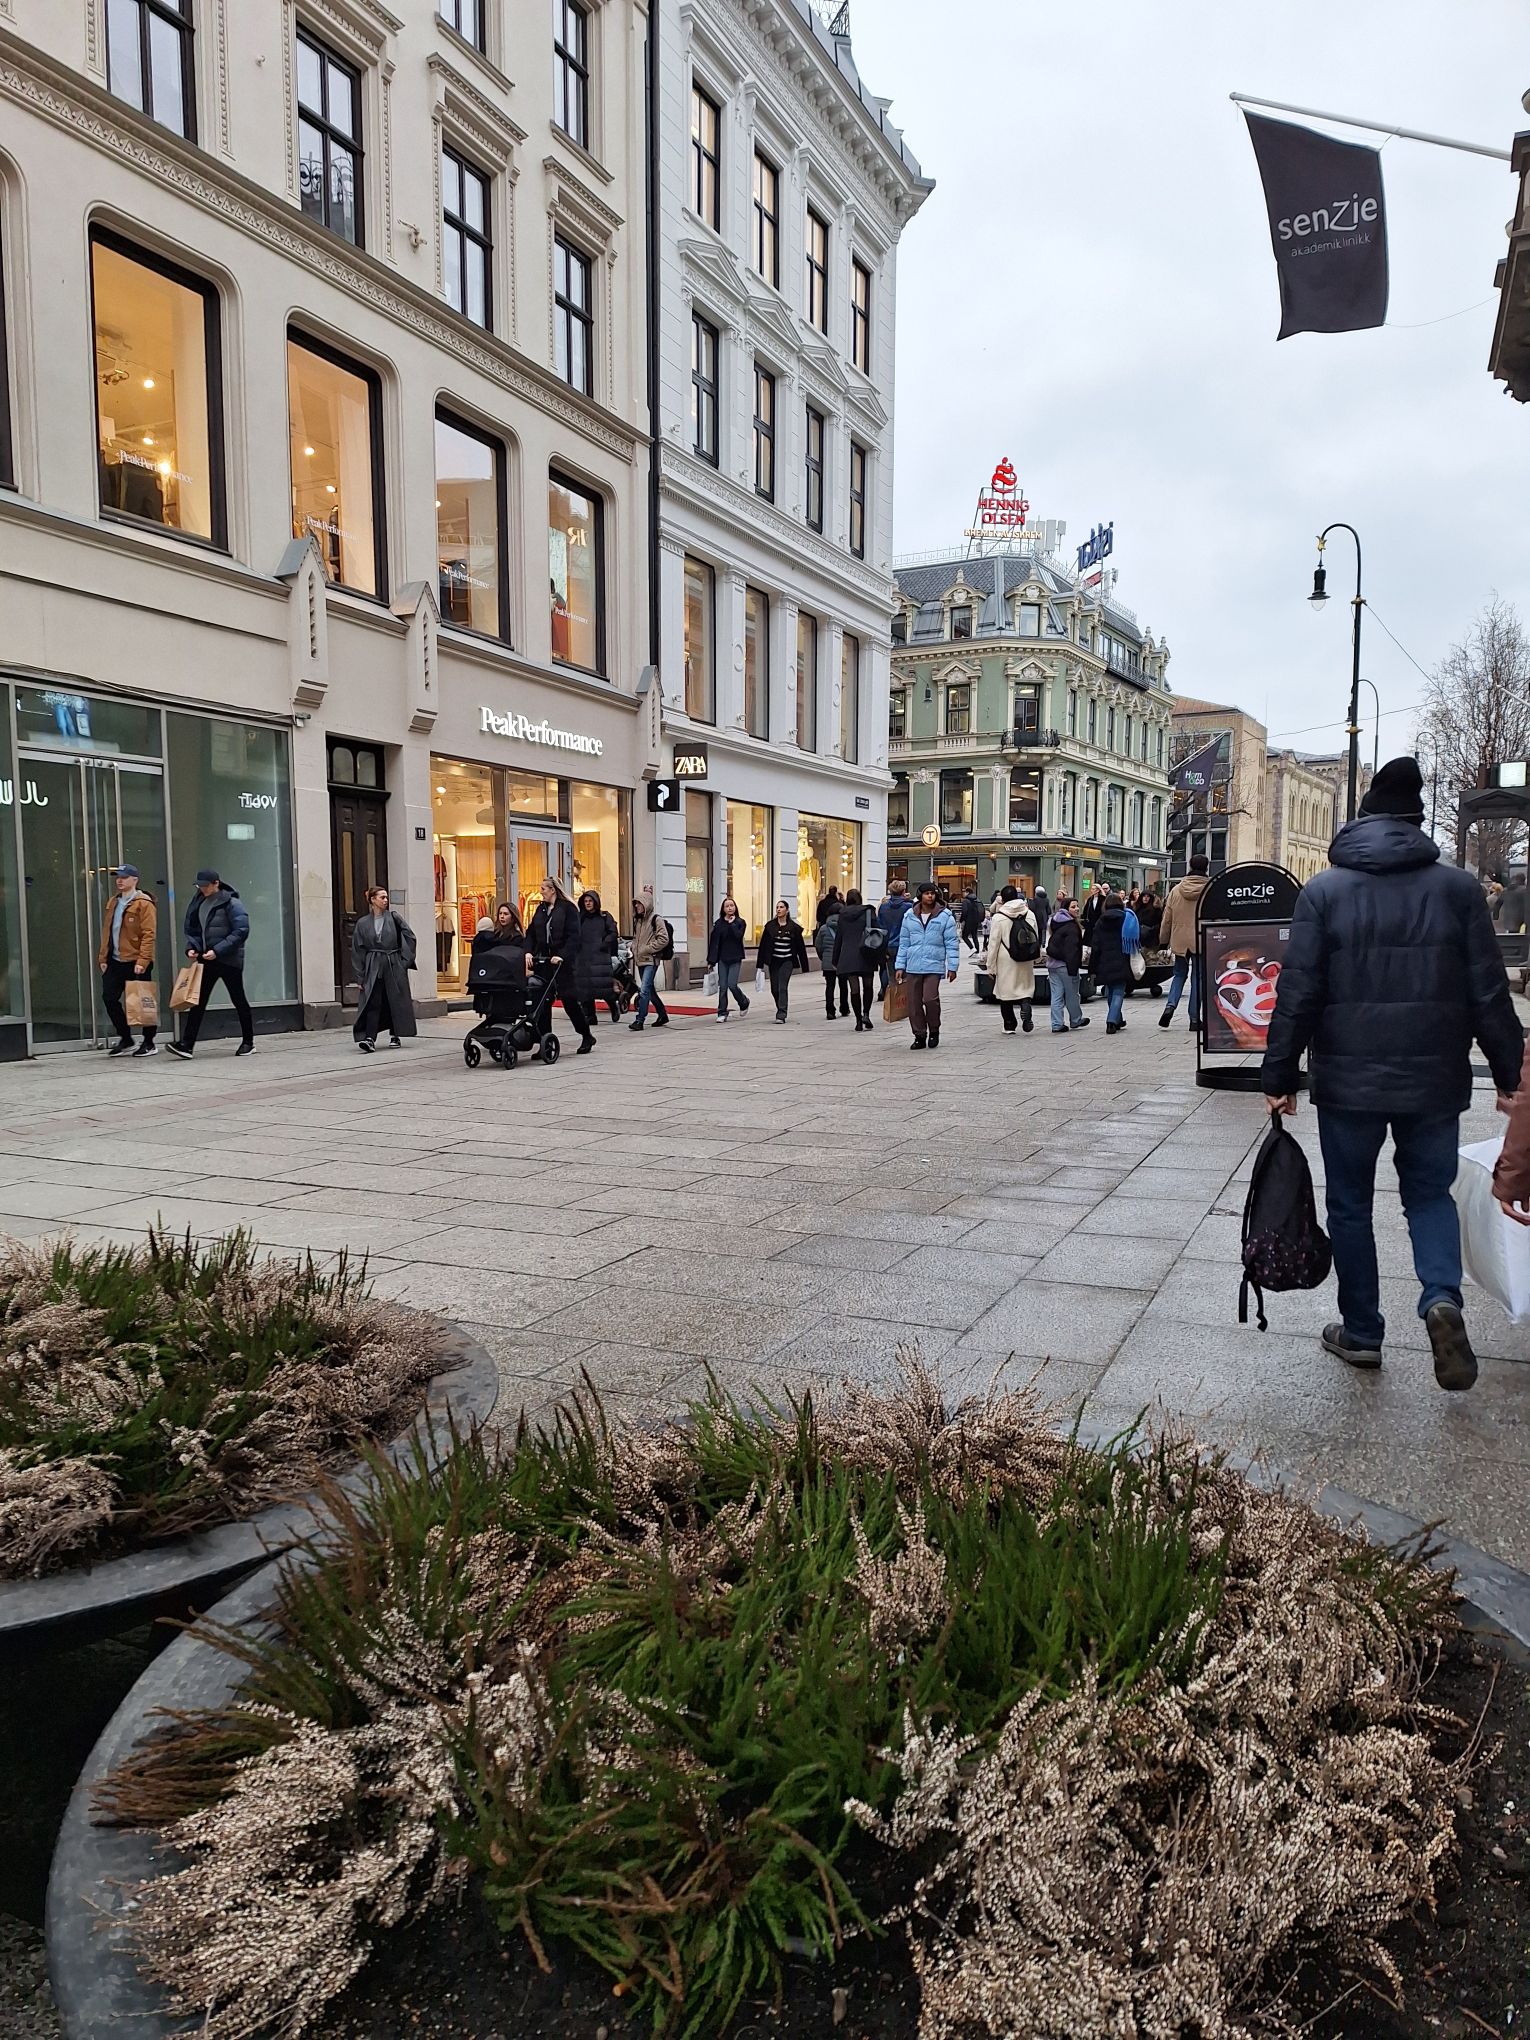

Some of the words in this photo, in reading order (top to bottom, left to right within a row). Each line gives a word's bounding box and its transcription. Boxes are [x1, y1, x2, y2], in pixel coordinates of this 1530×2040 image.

[977, 498, 1029, 511] HENNIG
[982, 512, 1025, 525] OLSEN
[480, 705, 603, 755] PeakPerformance
[674, 756, 706, 775] ZARA
